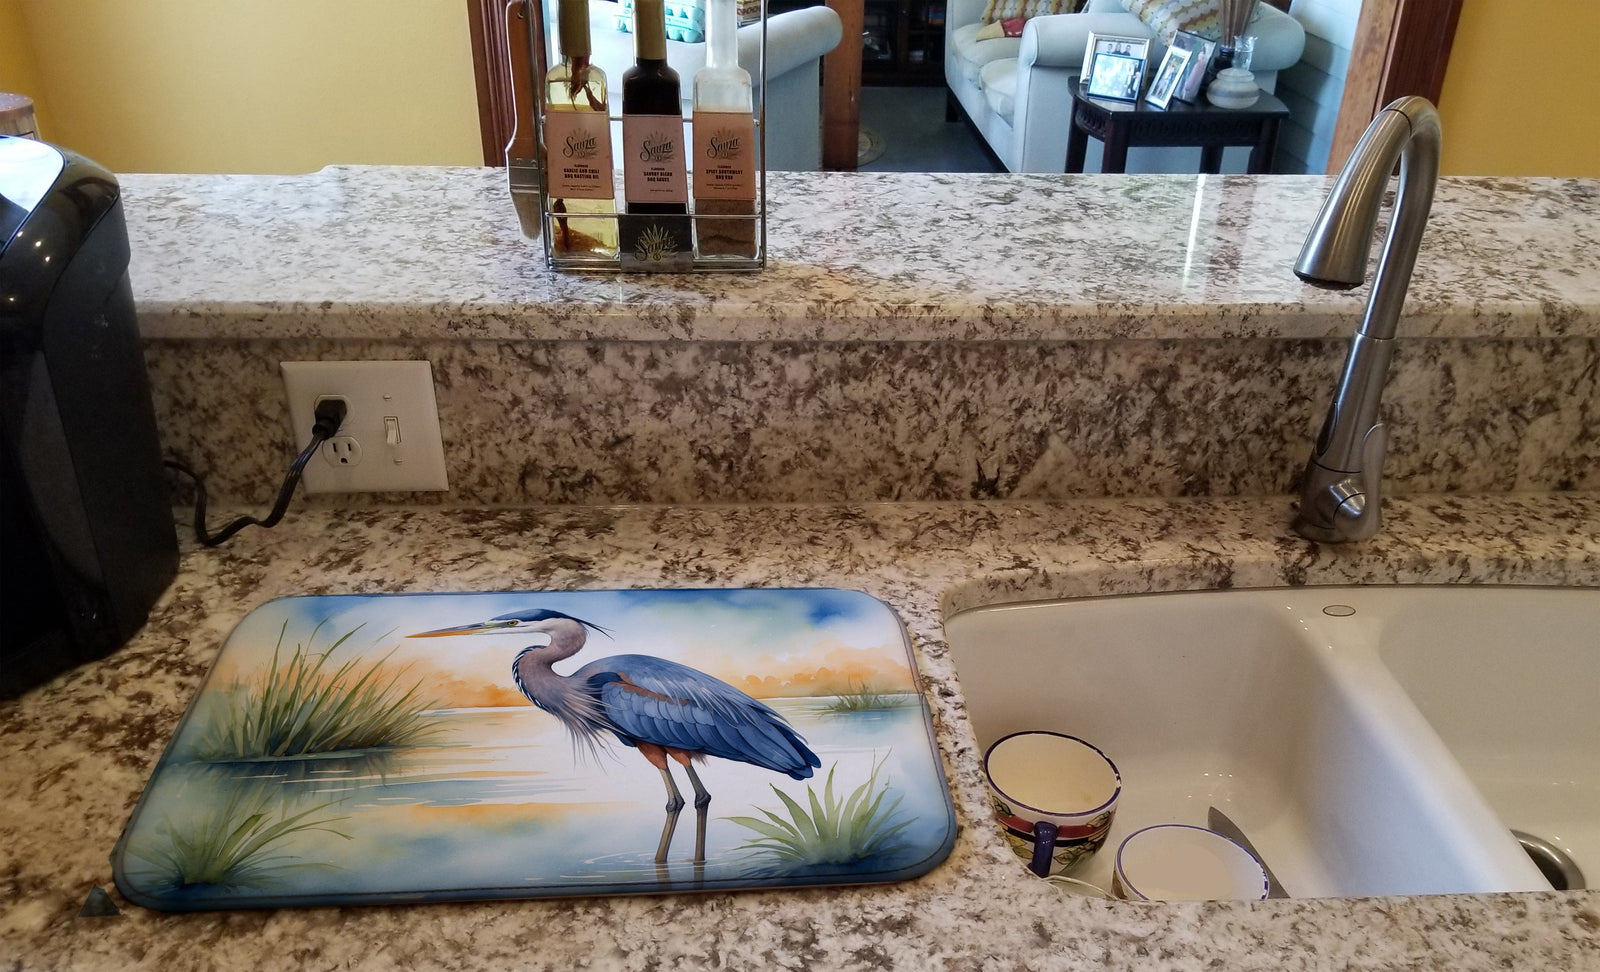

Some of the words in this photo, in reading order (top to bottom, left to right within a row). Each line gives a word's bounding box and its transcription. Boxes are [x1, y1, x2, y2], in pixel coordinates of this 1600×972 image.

[562, 136, 597, 158] Sauza
[640, 140, 674, 162] Sauza
[706, 136, 740, 158] Sauza
